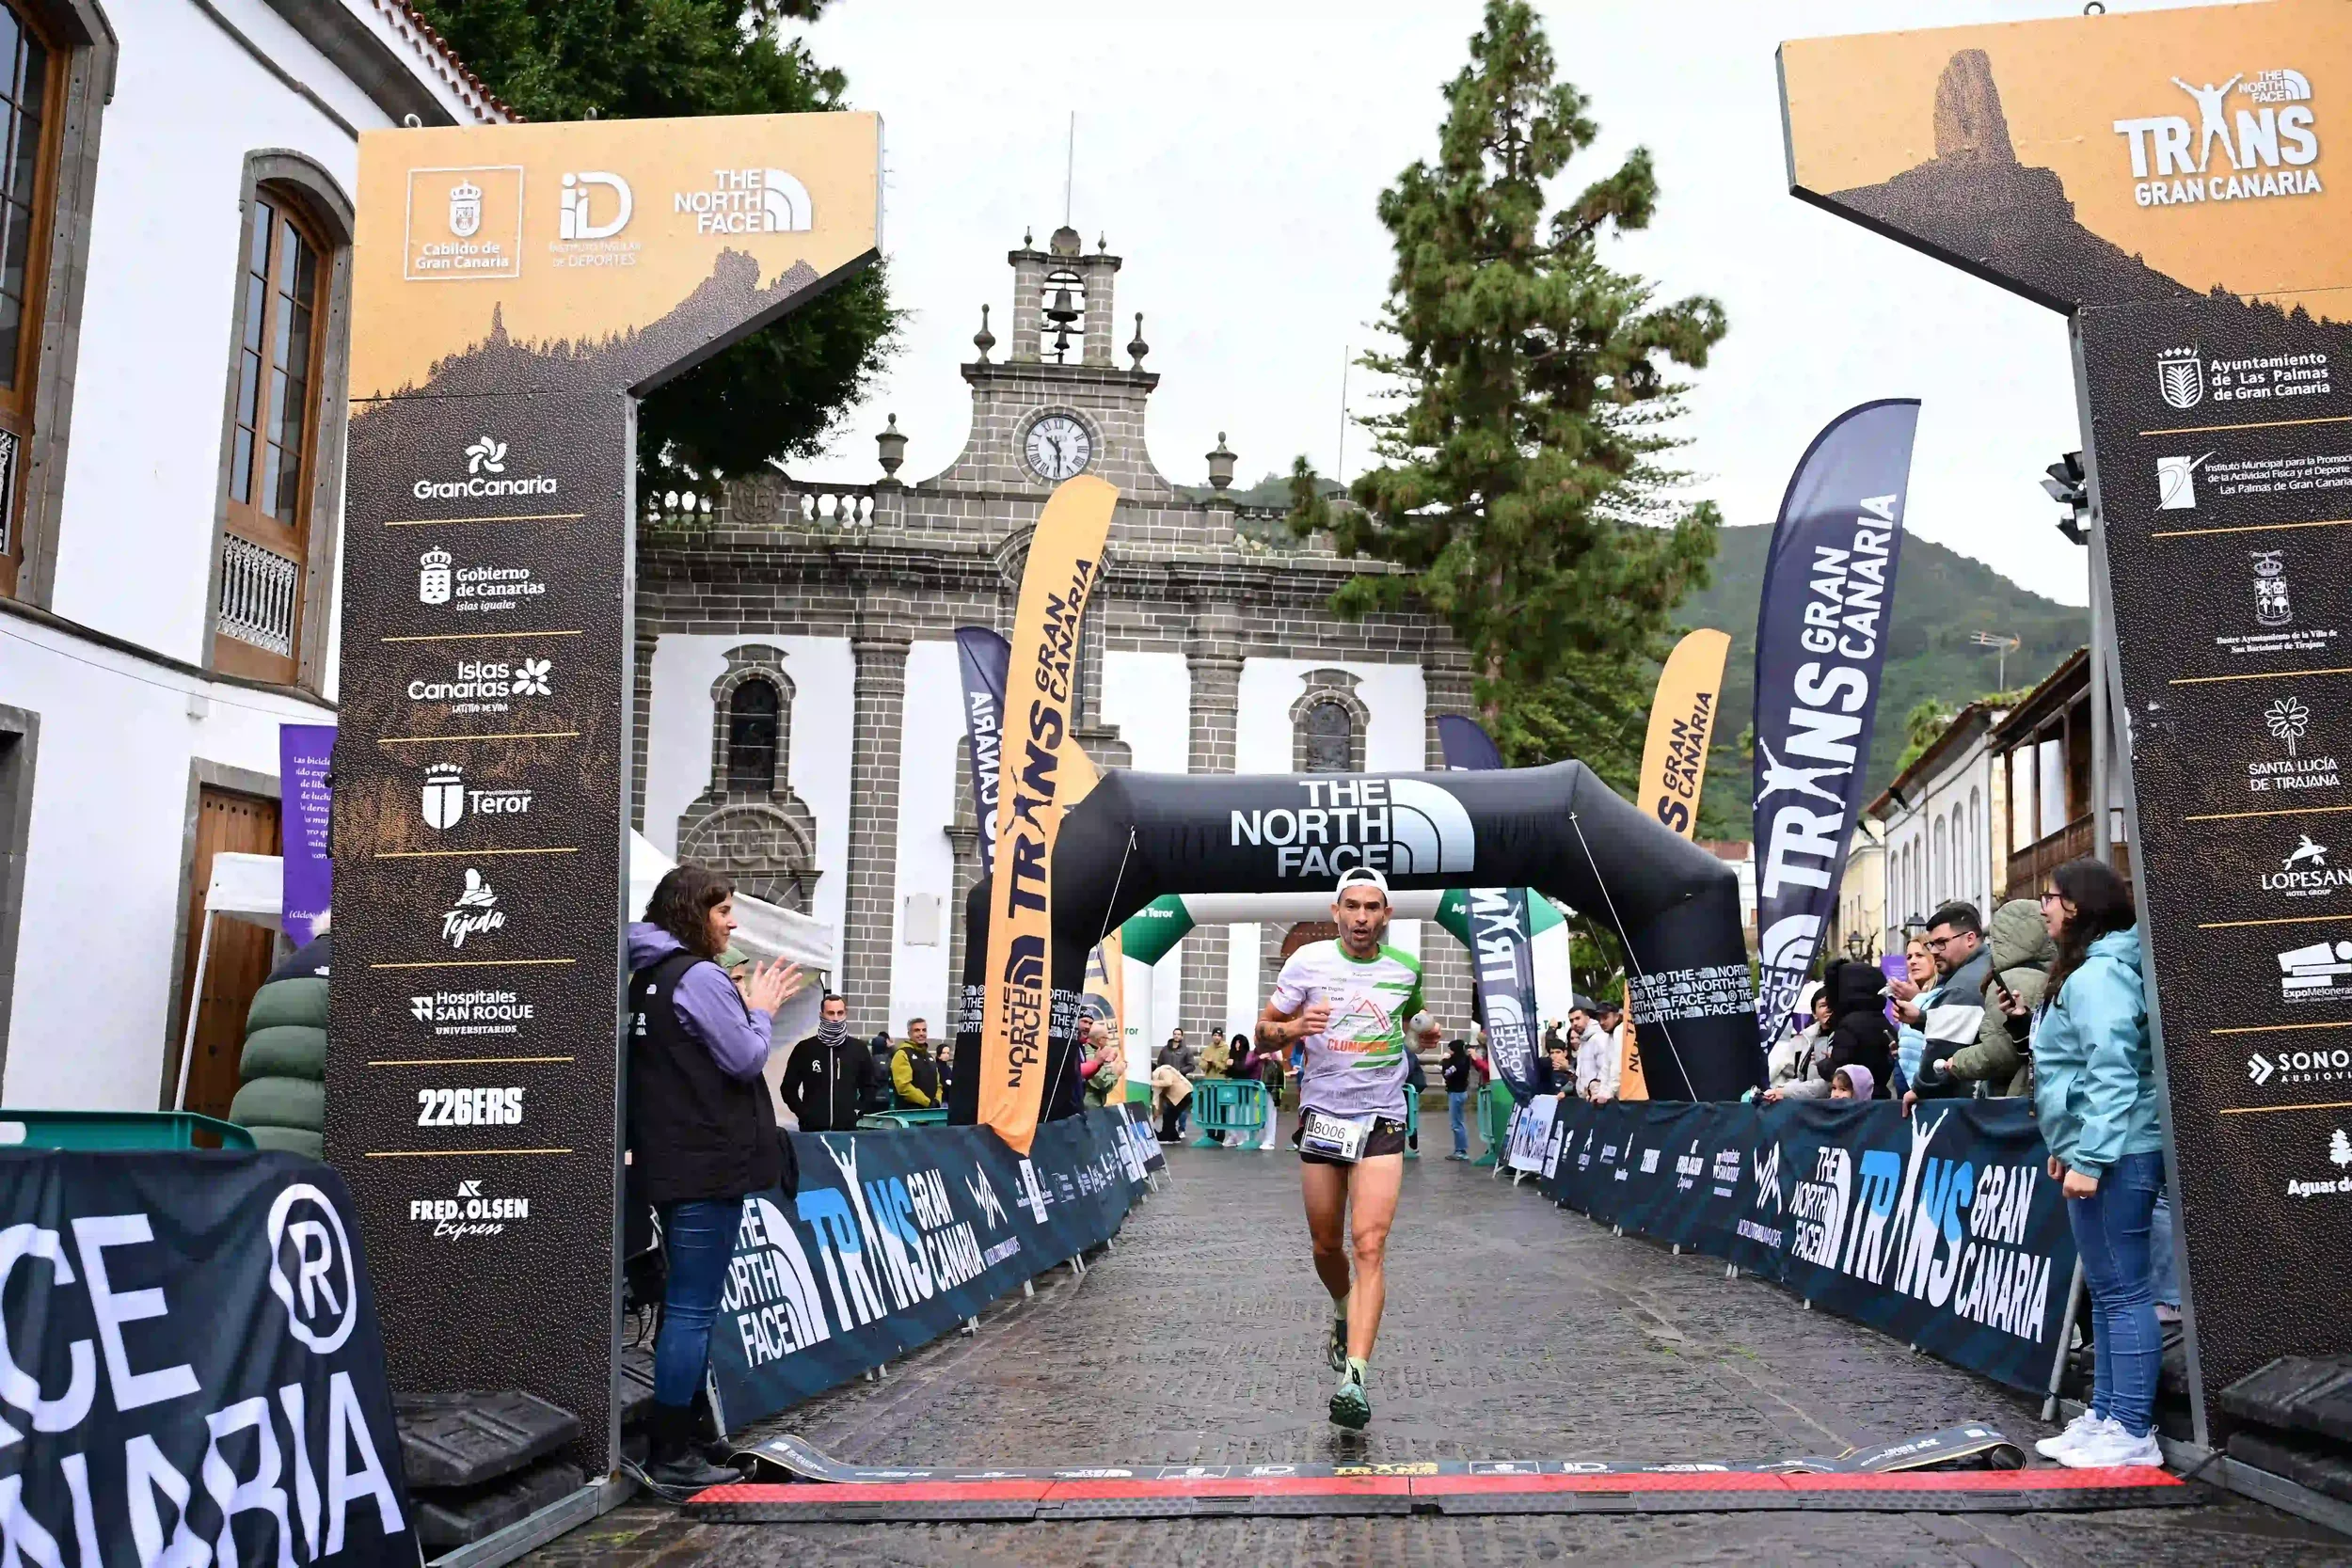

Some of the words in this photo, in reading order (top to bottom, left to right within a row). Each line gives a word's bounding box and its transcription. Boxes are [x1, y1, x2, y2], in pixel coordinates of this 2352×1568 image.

[2256, 70, 2283, 81] THE
[2238, 80, 2284, 93] NORTH
[2251, 91, 2285, 103] FACE
[714, 169, 762, 189] THE
[2135, 178, 2205, 207] GRAN
[2209, 169, 2322, 200] CANARIA
[674, 191, 763, 213] NORTH
[697, 211, 763, 234] FACE
[422, 243, 478, 256] Cabildo
[483, 241, 501, 253] de
[415, 257, 451, 270] Gran
[454, 255, 509, 269] Canaria
[568, 253, 636, 267] DEPORTES
[2211, 354, 2328, 374] Ayuntamiento
[2213, 375, 2231, 387] de
[2240, 372, 2265, 385] Las
[2274, 368, 2328, 382] Palmas
[2214, 388, 2233, 401] de
[2235, 385, 2271, 400] Gran
[2275, 381, 2330, 396] Canaria
[2205, 464, 2240, 472] Instituto
[2242, 459, 2283, 472] Municipal
[2285, 458, 2305, 468] para
[2307, 456, 2314, 465] la
[2208, 474, 2219, 483] de
[2221, 473, 2229, 482] la
[2231, 469, 2270, 481] Actividad
[2297, 469, 2303, 478] y
[2305, 467, 2312, 475] el
[2314, 465, 2350, 477] Deporte
[413, 475, 557, 499] GranCanaria
[2220, 484, 2236, 495] Las
[2238, 482, 2271, 494] Palmas
[2274, 481, 2286, 491] de
[2289, 479, 2313, 489] Gran
[2315, 477, 2352, 488] Canaria
[456, 567, 529, 582] Gobierno
[1801, 546, 1851, 654] GRAN
[1838, 494, 1898, 659] CANARIA
[455, 583, 474, 597] de
[477, 580, 546, 596] Canarias
[456, 600, 478, 611] islas
[480, 598, 516, 612] iguales
[1049, 559, 1092, 704] CANARIA
[2242, 632, 2290, 643] Ayuntamiento
[2311, 629, 2328, 639] Villa
[2328, 629, 2338, 638] de
[1034, 592, 1066, 692] GRAN
[2232, 645, 2245, 654] San
[2296, 640, 2325, 651] Tirajana
[458, 660, 509, 680] Islas
[407, 679, 509, 700] Canarias
[1661, 718, 1690, 793] GRAN
[1677, 691, 1712, 802] CANARIA
[2249, 760, 2295, 775] SANTA
[2297, 756, 2338, 772] LUCÍA
[300, 779, 310, 788] de
[2250, 778, 2269, 791] DE
[2276, 773, 2341, 790] TIRAJANA
[301, 791, 310, 800] de
[469, 791, 532, 814] Teror
[1299, 779, 1387, 807] THE
[1231, 807, 1389, 846] NORTH
[1278, 845, 1390, 878] FACE
[2261, 868, 2352, 891] LOPESAN
[1149, 908, 1174, 918] Teror
[441, 909, 505, 948] Tejeda
[1667, 969, 1695, 983] THE
[1717, 964, 1750, 977] NORTH
[437, 990, 516, 1006] Hospitales
[1645, 985, 1668, 998] THE
[1692, 978, 1736, 992] NORTH
[1671, 992, 1707, 1006] FACE
[1737, 988, 1753, 1000] THE
[967, 997, 984, 1008] THE
[436, 1006, 469, 1021] SAN
[472, 1005, 533, 1020] ROQUE
[1052, 1014, 1071, 1026] THE
[1641, 1009, 1680, 1024] NORTH
[1705, 1003, 1737, 1016] FACE
[436, 1024, 516, 1035] UNIVERSITARIOS
[1009, 987, 1028, 1088] NORTH
[1022, 992, 1043, 1065] FACE
[2278, 1049, 2350, 1071] SONO
[418, 1087, 522, 1126] 226ERS
[1313, 1121, 1345, 1139] 8006
[1815, 1146, 1841, 1183] THE
[2287, 1180, 2337, 1197] Aguas
[907, 1169, 954, 1232] GRAN
[1788, 1180, 1831, 1222] NORTH
[1970, 1164, 2038, 1245] GRAN
[433, 1218, 503, 1241] Express
[1791, 1220, 1822, 1260] FACE
[928, 1221, 987, 1292] CANARIA
[721, 1250, 781, 1313] ORTH
[1953, 1242, 2051, 1344] CANARIA
[738, 1303, 796, 1369] FACE
